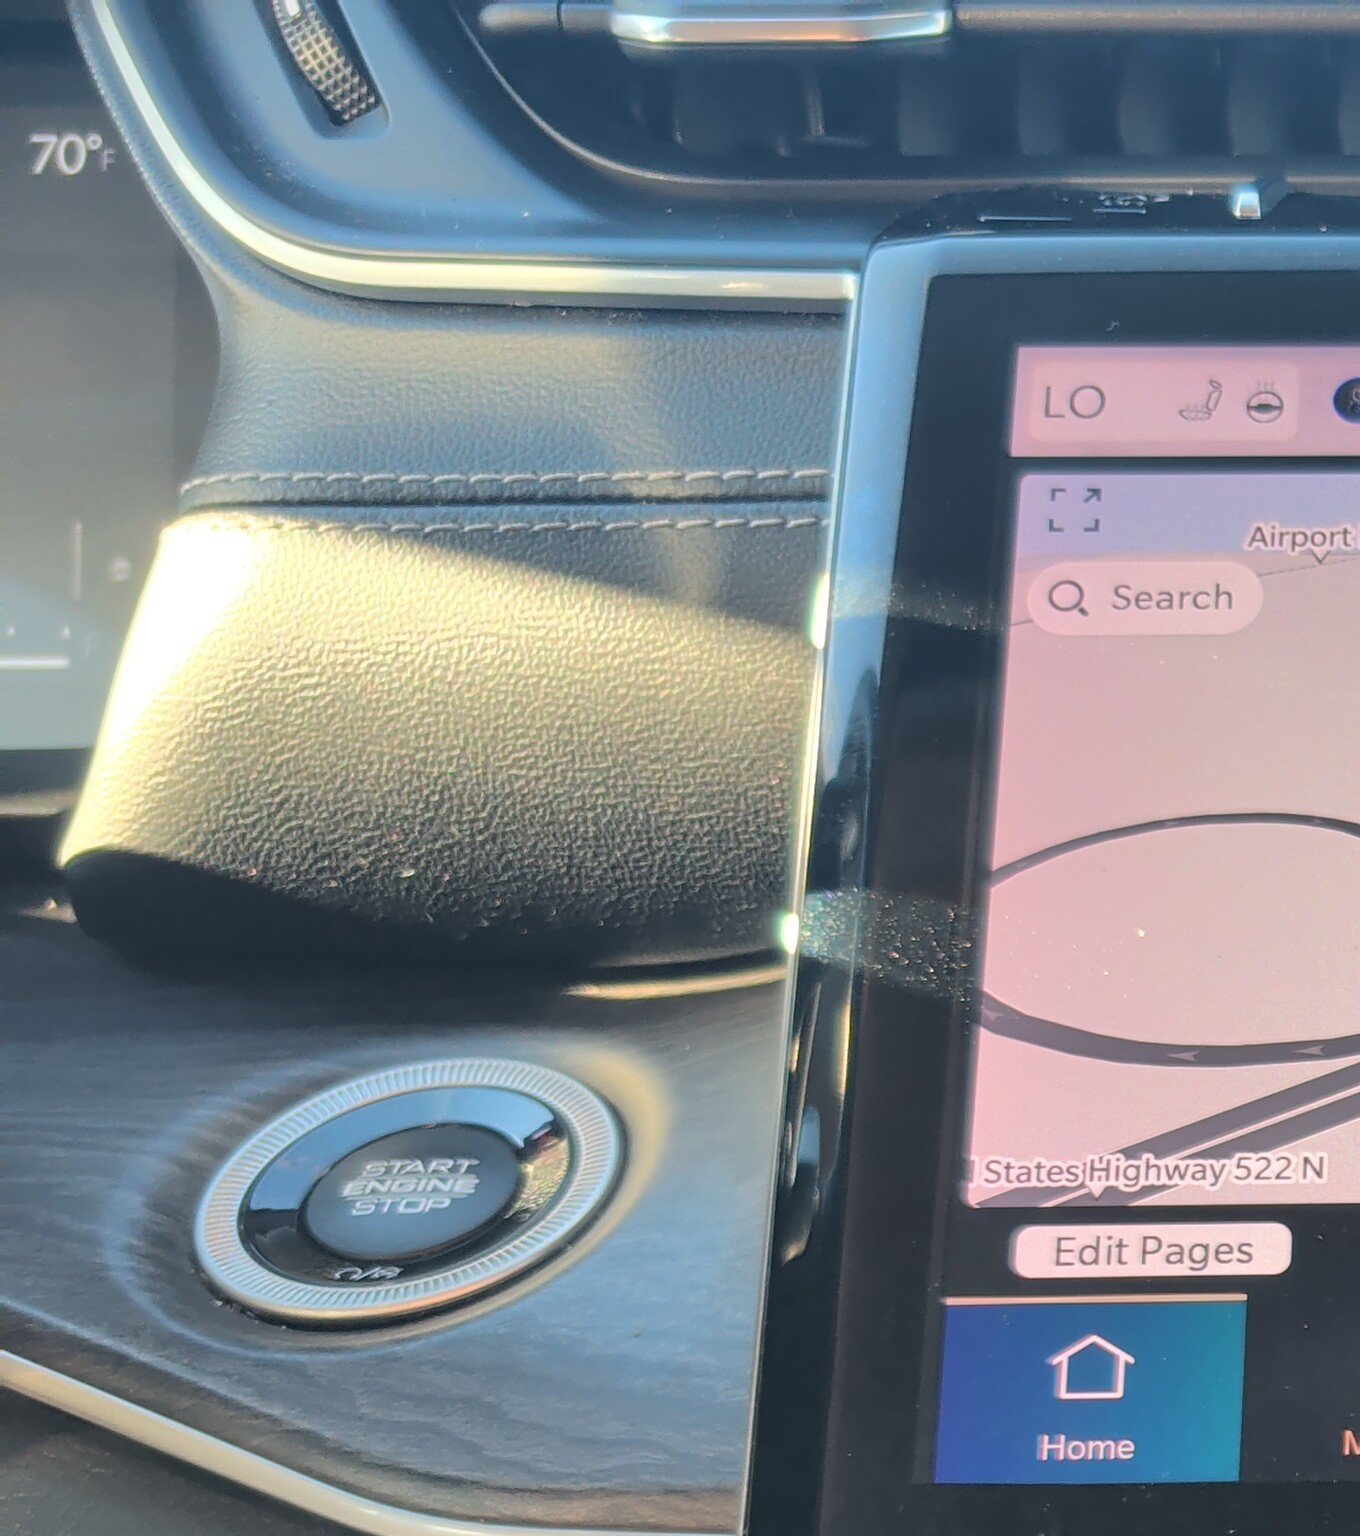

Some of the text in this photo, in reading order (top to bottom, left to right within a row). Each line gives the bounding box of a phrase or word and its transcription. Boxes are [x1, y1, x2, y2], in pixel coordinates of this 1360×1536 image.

[1044, 384, 1107, 420] LO
[1247, 525, 1352, 554] Airport
[1111, 583, 1234, 612] Search
[362, 1157, 481, 1178] START
[984, 1159, 1078, 1184] States
[1089, 1156, 1226, 1187] Highway
[1233, 1156, 1292, 1181] 522
[1302, 1156, 1325, 1180] N
[342, 1177, 481, 1198] ENGINE
[350, 1197, 453, 1217] STOP
[1054, 1235, 1254, 1271] Edit Pages
[1038, 1433, 1136, 1461] Home
